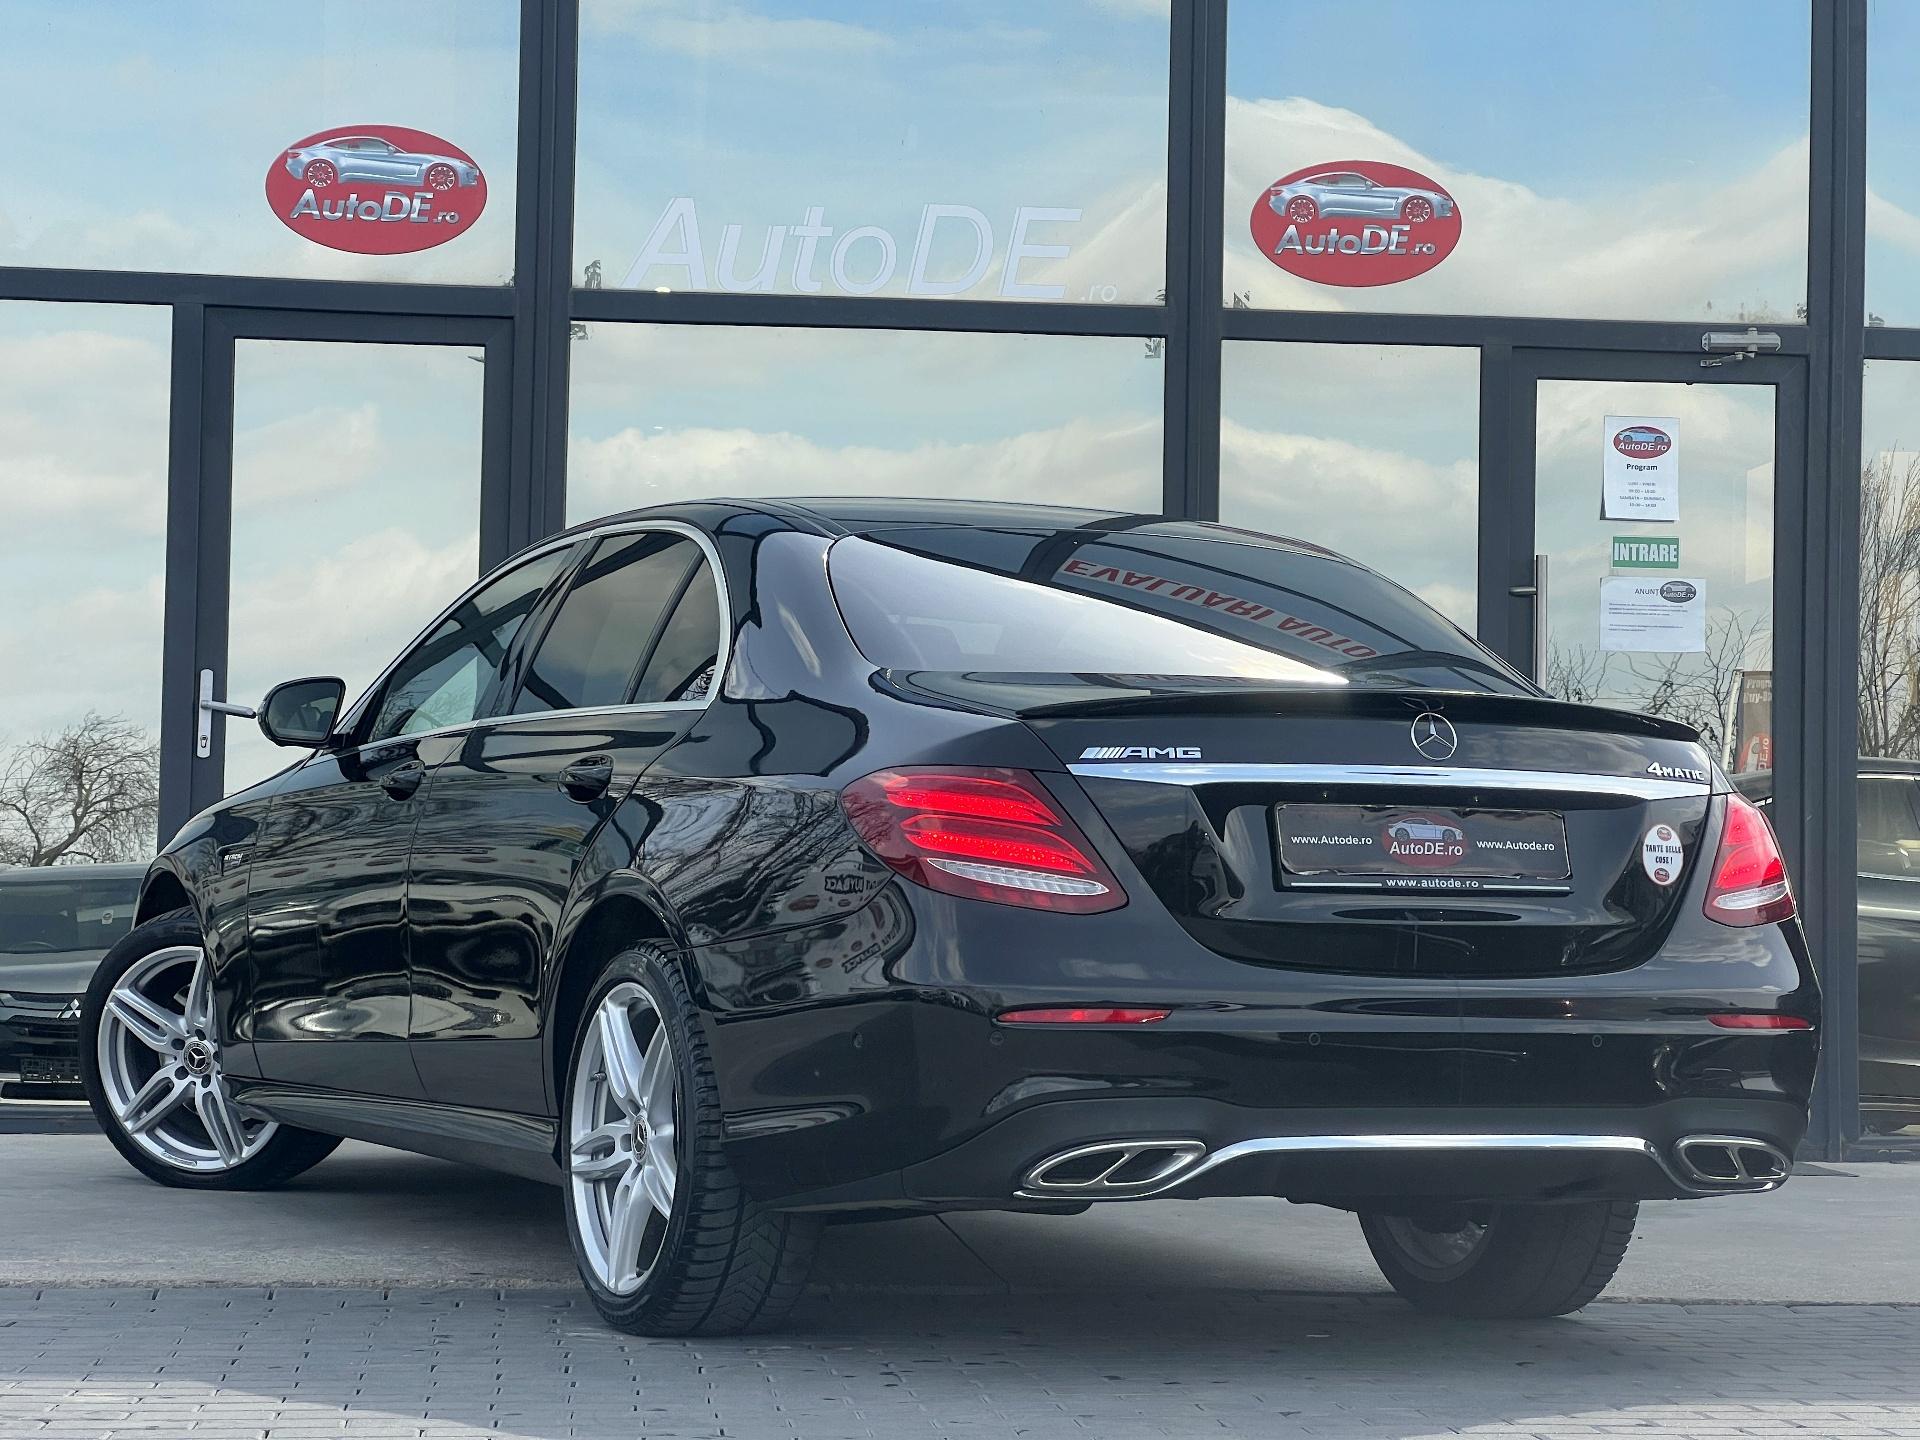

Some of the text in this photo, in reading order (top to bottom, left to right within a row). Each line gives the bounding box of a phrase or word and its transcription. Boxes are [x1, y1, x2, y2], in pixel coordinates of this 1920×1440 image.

[1617, 442, 1668, 452] AutoDE.ro
[1626, 464, 1658, 472] Program
[1614, 542, 1678, 562] INTRARE
[1119, 746, 1202, 760] AMG
[1646, 762, 1705, 781] 4MATIC
[1291, 834, 1373, 845] www.Autode.ro
[1476, 839, 1556, 852] www.Autode.ro
[1389, 841, 1464, 857] AutoDE.ro
[1385, 877, 1480, 889] www.autode.ro
